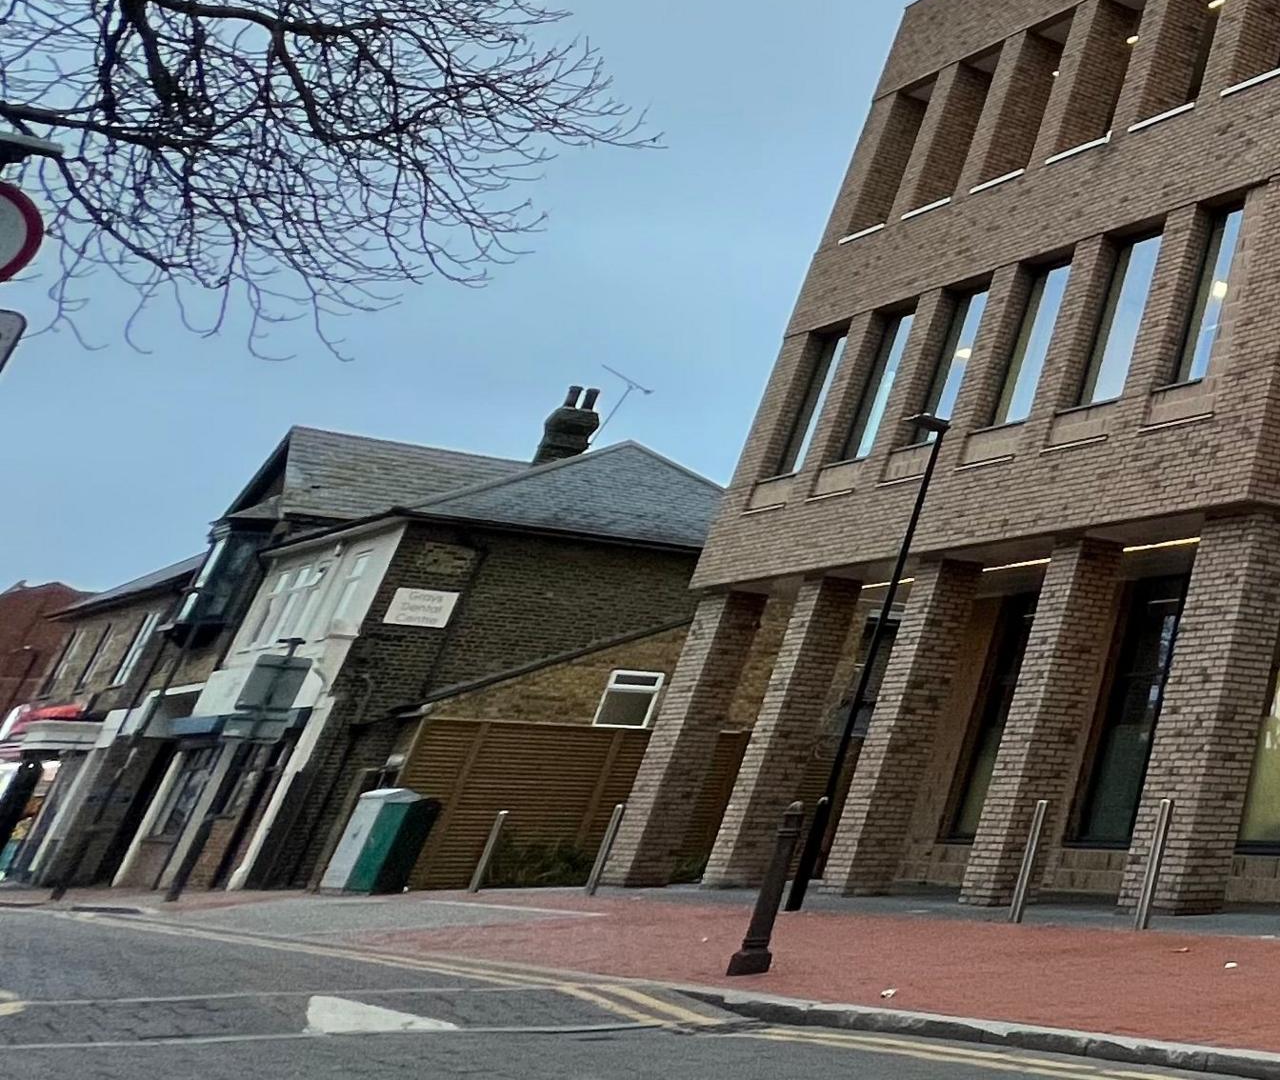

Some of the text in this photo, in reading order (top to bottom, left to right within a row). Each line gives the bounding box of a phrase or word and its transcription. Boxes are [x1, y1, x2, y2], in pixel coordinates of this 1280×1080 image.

[409, 591, 444, 603] Grays
[400, 602, 443, 613] Dental
[395, 613, 438, 624] Centre
